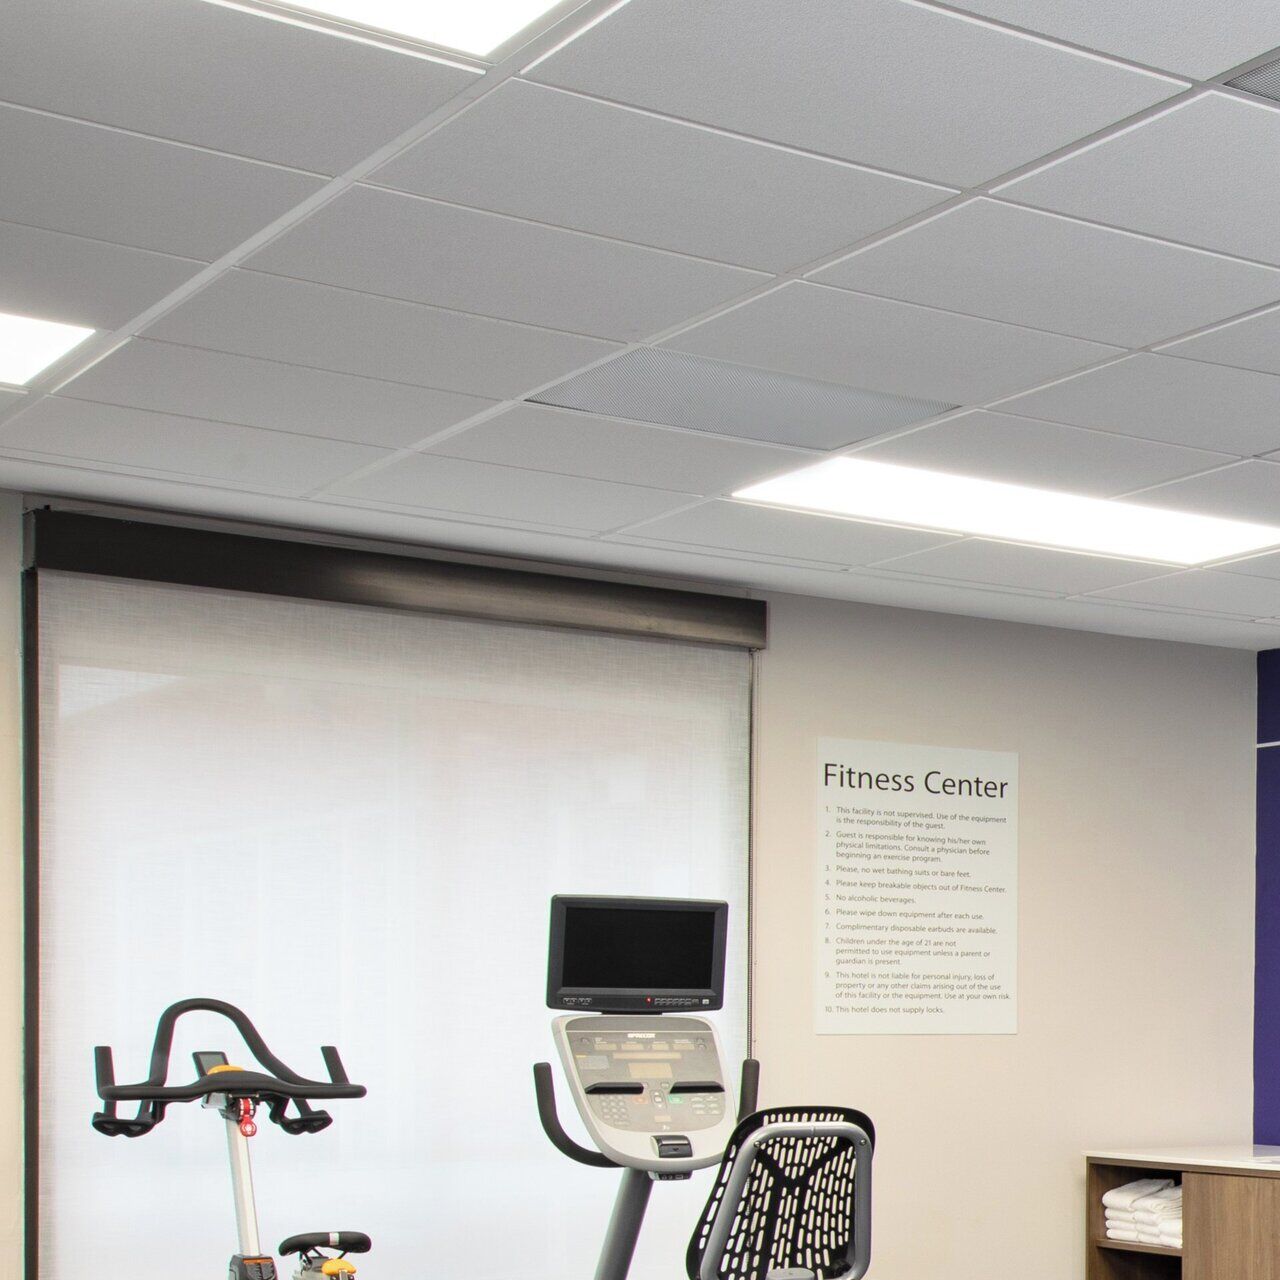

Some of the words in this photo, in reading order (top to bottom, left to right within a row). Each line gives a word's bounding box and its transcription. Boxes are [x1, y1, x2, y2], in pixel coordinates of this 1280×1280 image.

[824, 763, 915, 792] Fitness
[924, 771, 1008, 799] Center
[852, 808, 875, 817] facility
[971, 815, 1007, 825] equipment
[857, 818, 901, 828] responsibility
[836, 831, 856, 839] Guest
[865, 833, 904, 843] responsible
[917, 835, 946, 845] knowing
[947, 837, 970, 846] his/her
[836, 842, 864, 851] physical
[937, 846, 967, 856] physician
[969, 847, 990, 855] before
[836, 851, 871, 861] beginning
[883, 853, 910, 861] exercise
[887, 868, 913, 877] bathing
[860, 881, 876, 890] keep
[913, 883, 937, 892] objects
[859, 909, 876, 918] wipe
[899, 911, 936, 920] equipment
[836, 923, 888, 933] Complimentary
[890, 925, 926, 934] disposable
[836, 948, 870, 956] permitted
[894, 949, 931, 957] equipment
[961, 950, 981, 958] parent
[836, 958, 866, 966] guardian
[922, 973, 951, 982] personal
[836, 982, 866, 990] property
[933, 983, 954, 991] arising
[859, 992, 881, 1000] facility
[903, 1006, 924, 1015] supply
